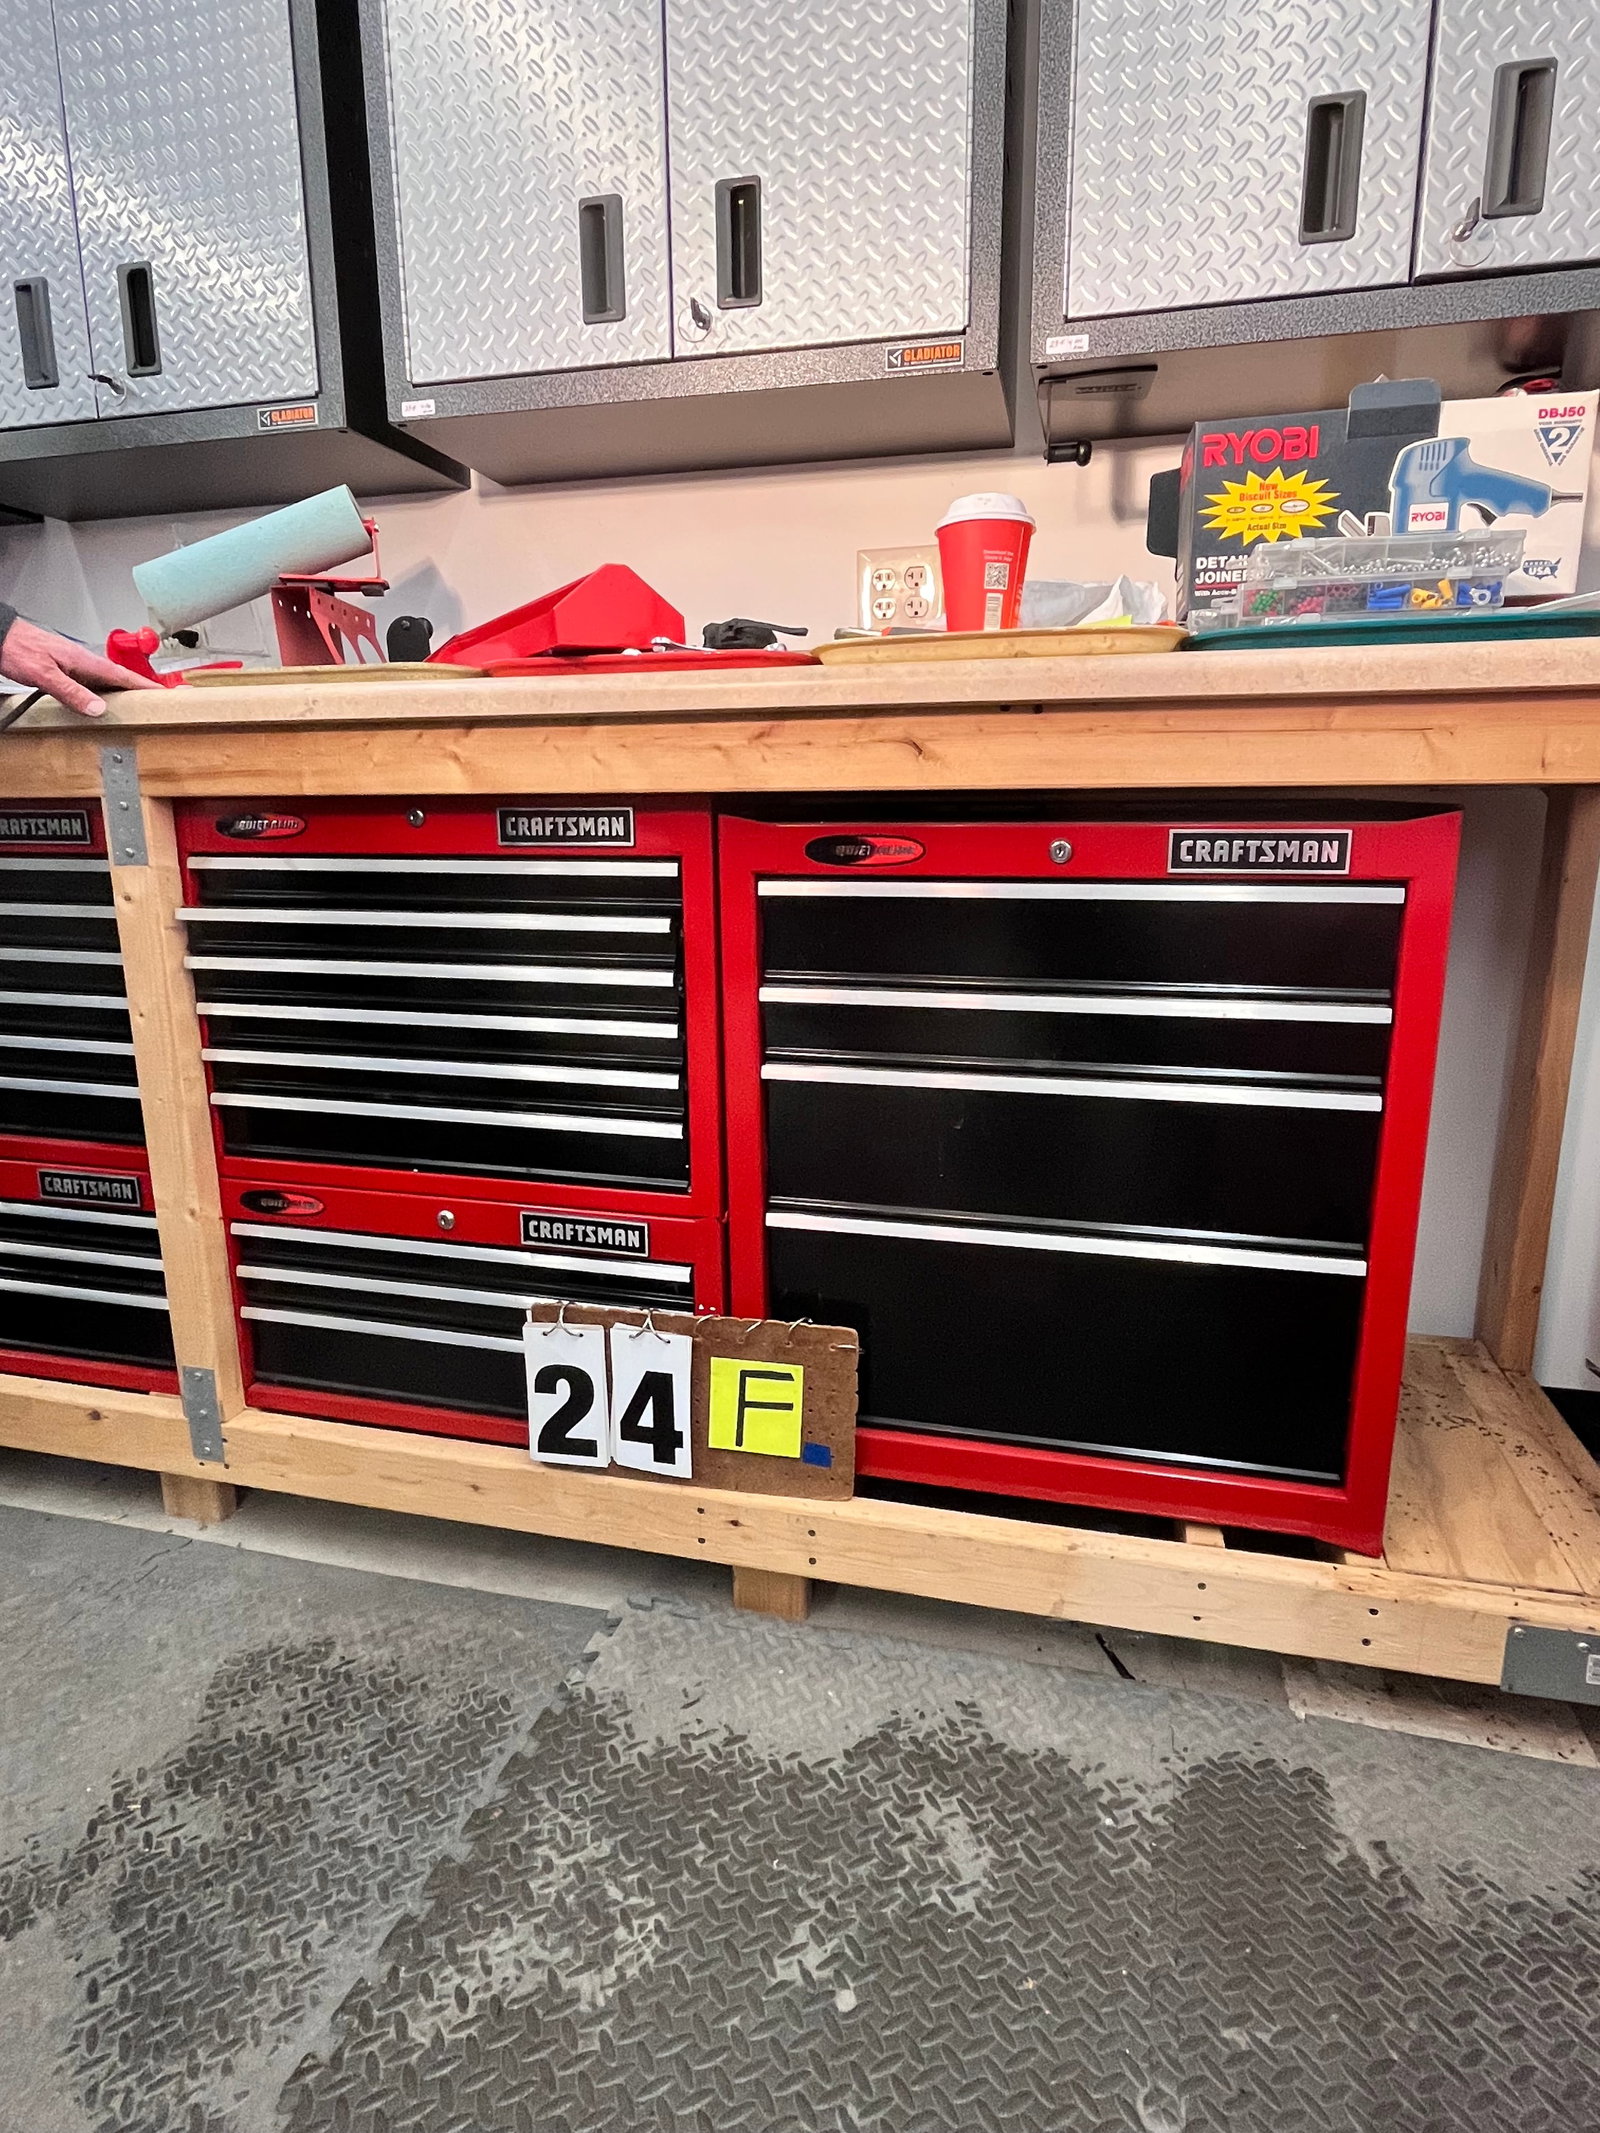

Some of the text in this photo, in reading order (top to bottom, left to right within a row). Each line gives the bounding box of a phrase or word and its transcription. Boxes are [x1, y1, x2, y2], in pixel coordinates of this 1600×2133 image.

[904, 344, 960, 362] GLADIATOR
[271, 407, 314, 422] GLADIATOR
[1538, 406, 1586, 419] DBJ50
[1201, 425, 1320, 467] RYOBI
[1548, 427, 1571, 452] 2
[1239, 489, 1298, 502] Biscuit Sizes
[1259, 482, 1279, 491] New
[1411, 511, 1446, 522] RYOBI
[1246, 522, 1271, 531] Actual
[1528, 565, 1552, 576] USA
[0, 818, 82, 836] RAFTSMAN
[505, 816, 625, 837] CRAFTSMAN
[1179, 839, 1340, 864] CRAFTSMAN
[44, 1176, 133, 1200] CRAFTSMAN
[528, 1219, 641, 1248] CRAFTSMAN
[734, 1369, 795, 1447] F
